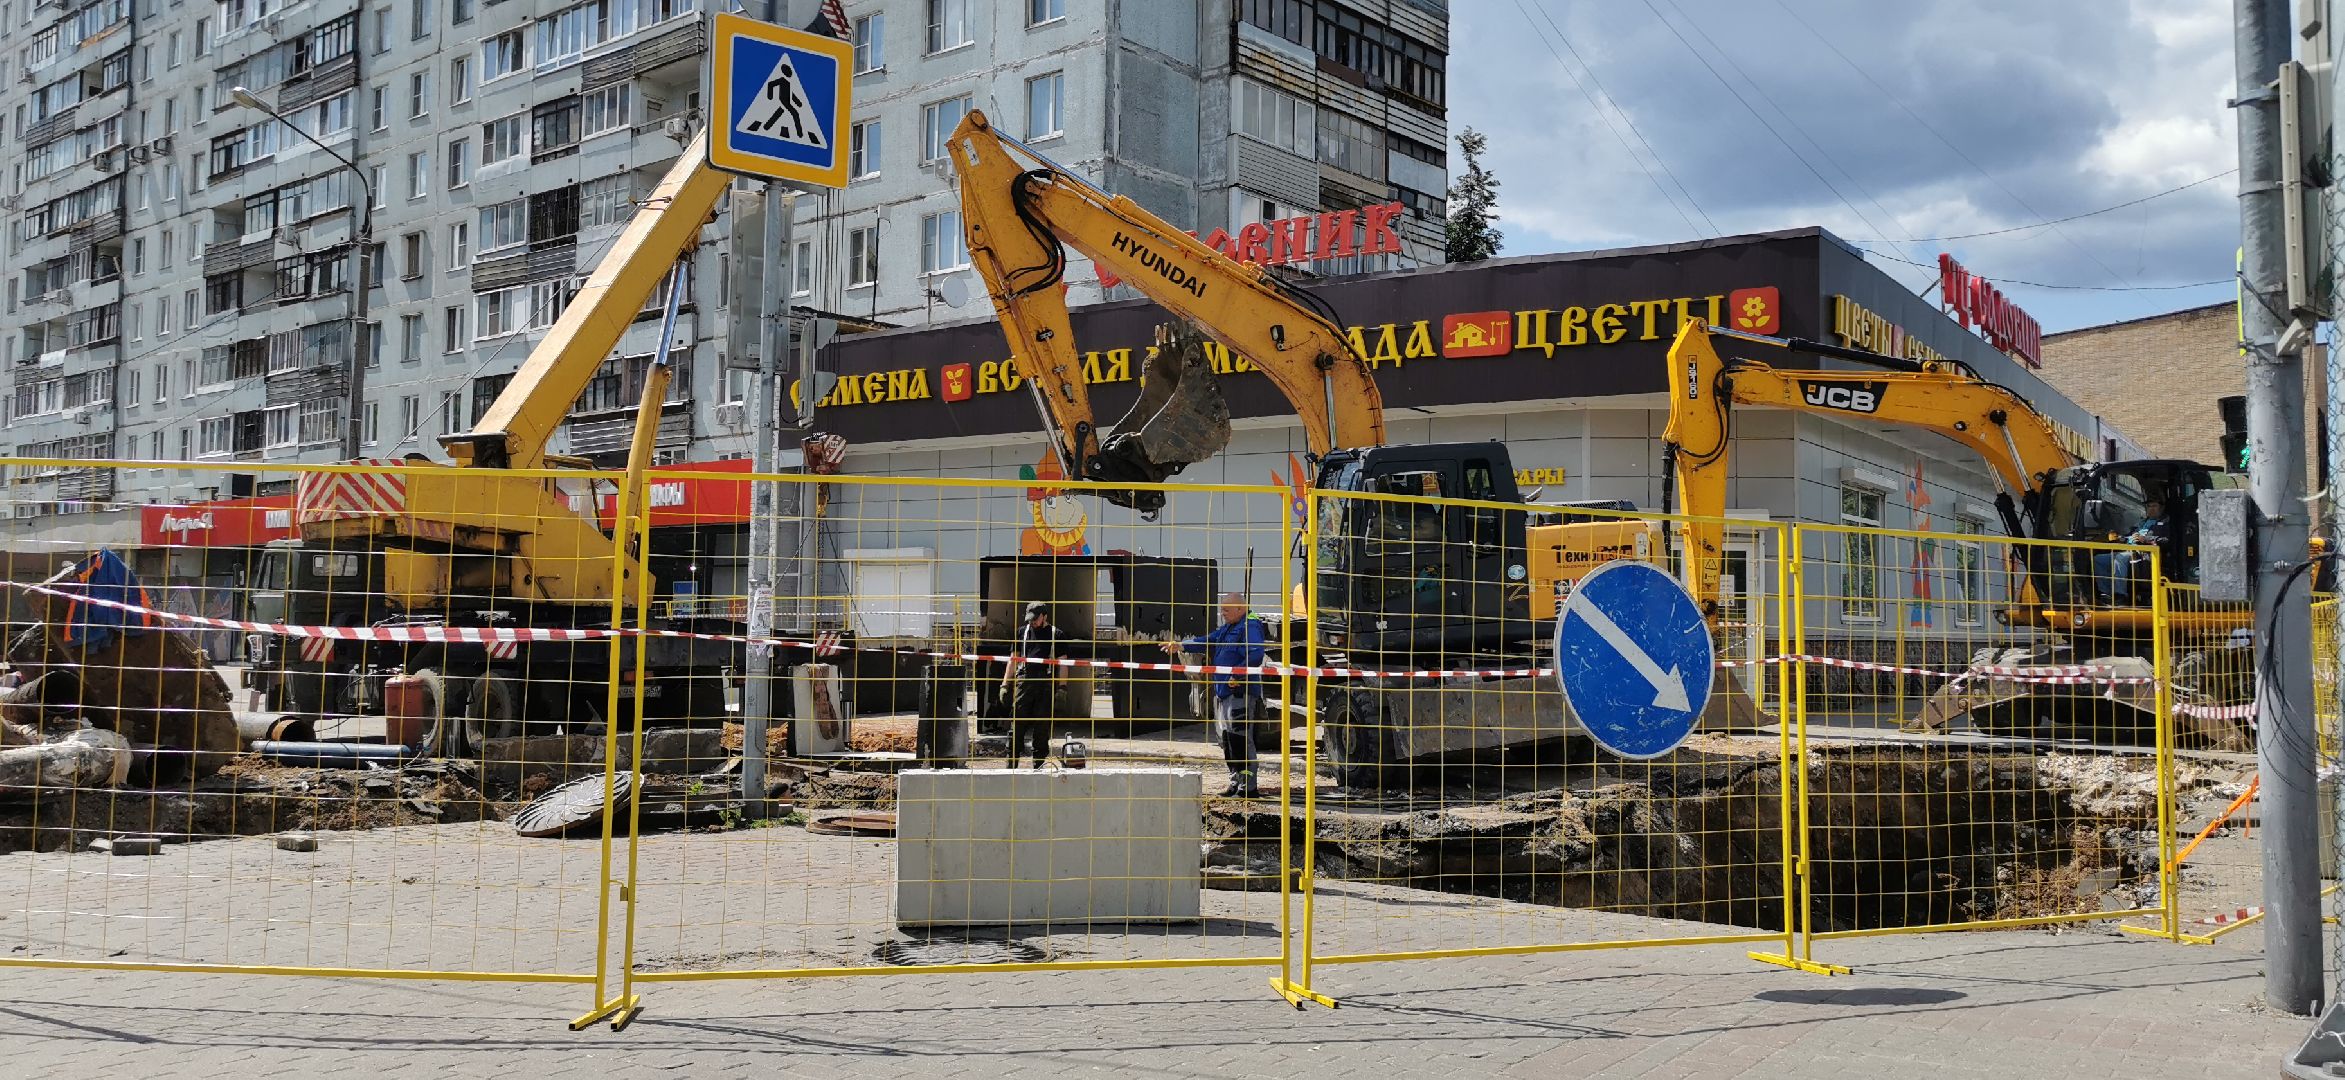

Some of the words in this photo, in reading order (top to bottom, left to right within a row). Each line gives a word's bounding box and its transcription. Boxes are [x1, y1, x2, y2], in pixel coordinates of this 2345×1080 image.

[1111, 230, 1207, 298] HYUNDAI
[1515, 294, 1725, 358] ЦВЕТЫ
[1834, 294, 1893, 358] ЦВЕТЫ
[1806, 386, 1875, 412] JCB
